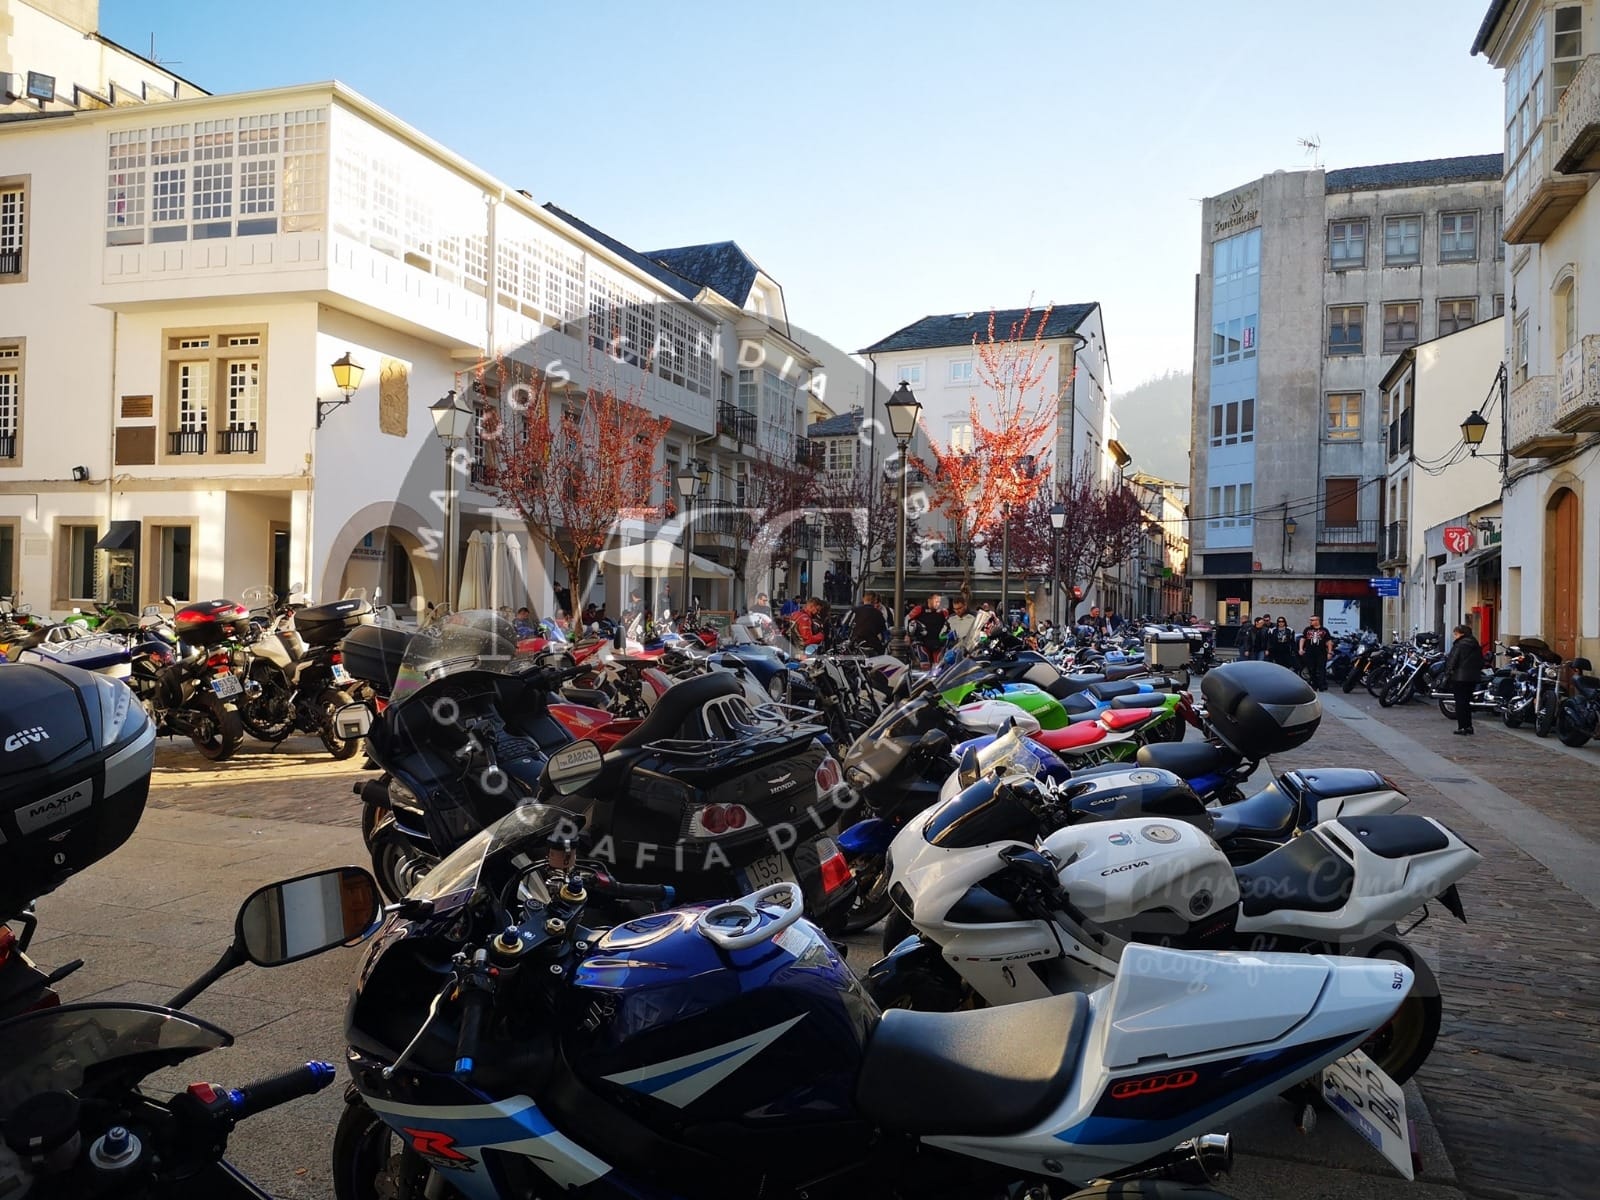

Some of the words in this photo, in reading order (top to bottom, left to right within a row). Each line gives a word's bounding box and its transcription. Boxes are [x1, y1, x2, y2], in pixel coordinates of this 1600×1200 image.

[1214, 208, 1259, 235] Santander
[4, 726, 50, 752] GIVI
[769, 779, 797, 794] HONDA
[29, 790, 83, 818] MAXIA
[1089, 794, 1128, 807] CAGIVA
[751, 851, 784, 883] 1557
[1100, 860, 1150, 878] CAGIVA
[1006, 951, 1042, 961] CAGIVA
[1112, 1070, 1198, 1099] 600
